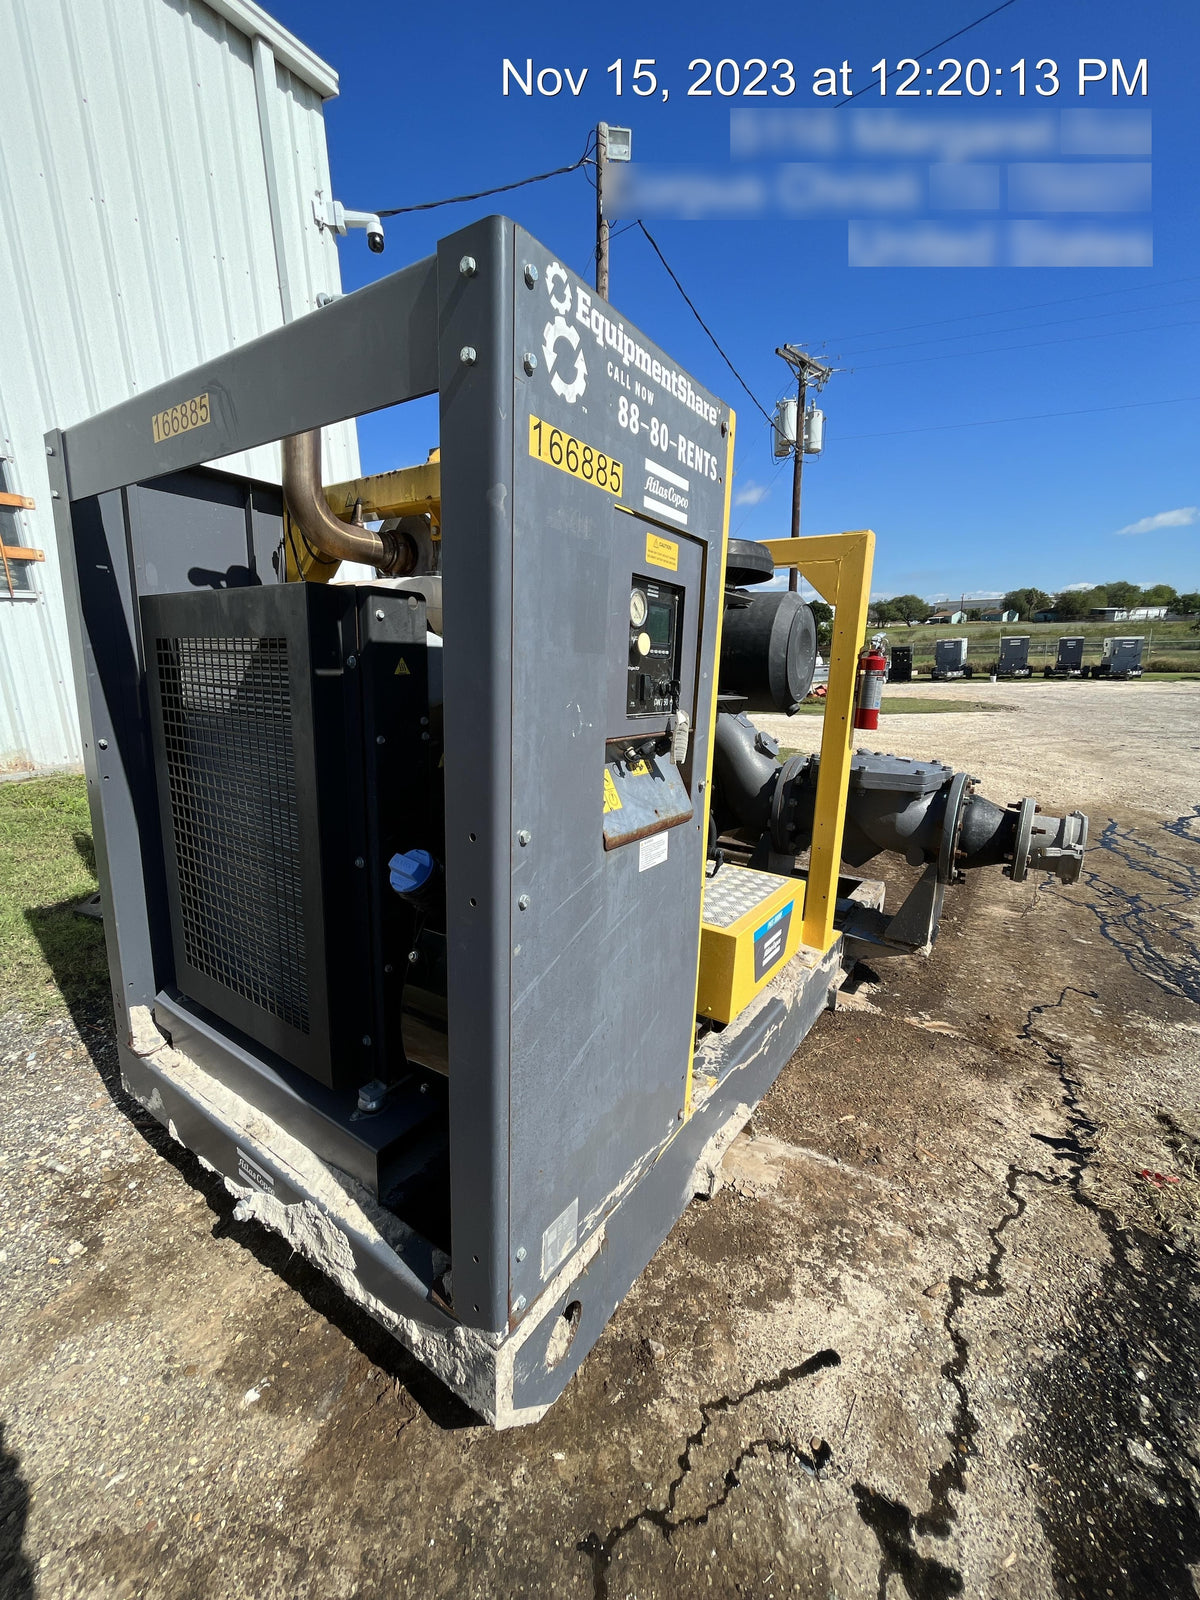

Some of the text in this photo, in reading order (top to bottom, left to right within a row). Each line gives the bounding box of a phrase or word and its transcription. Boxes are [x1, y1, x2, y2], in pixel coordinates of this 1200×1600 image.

[575, 286, 718, 427] EquipmentShare
[607, 361, 655, 406] CALL NOW
[153, 394, 209, 440] 166885
[618, 395, 718, 481] 88-80-RENTS
[533, 420, 622, 493] 166885
